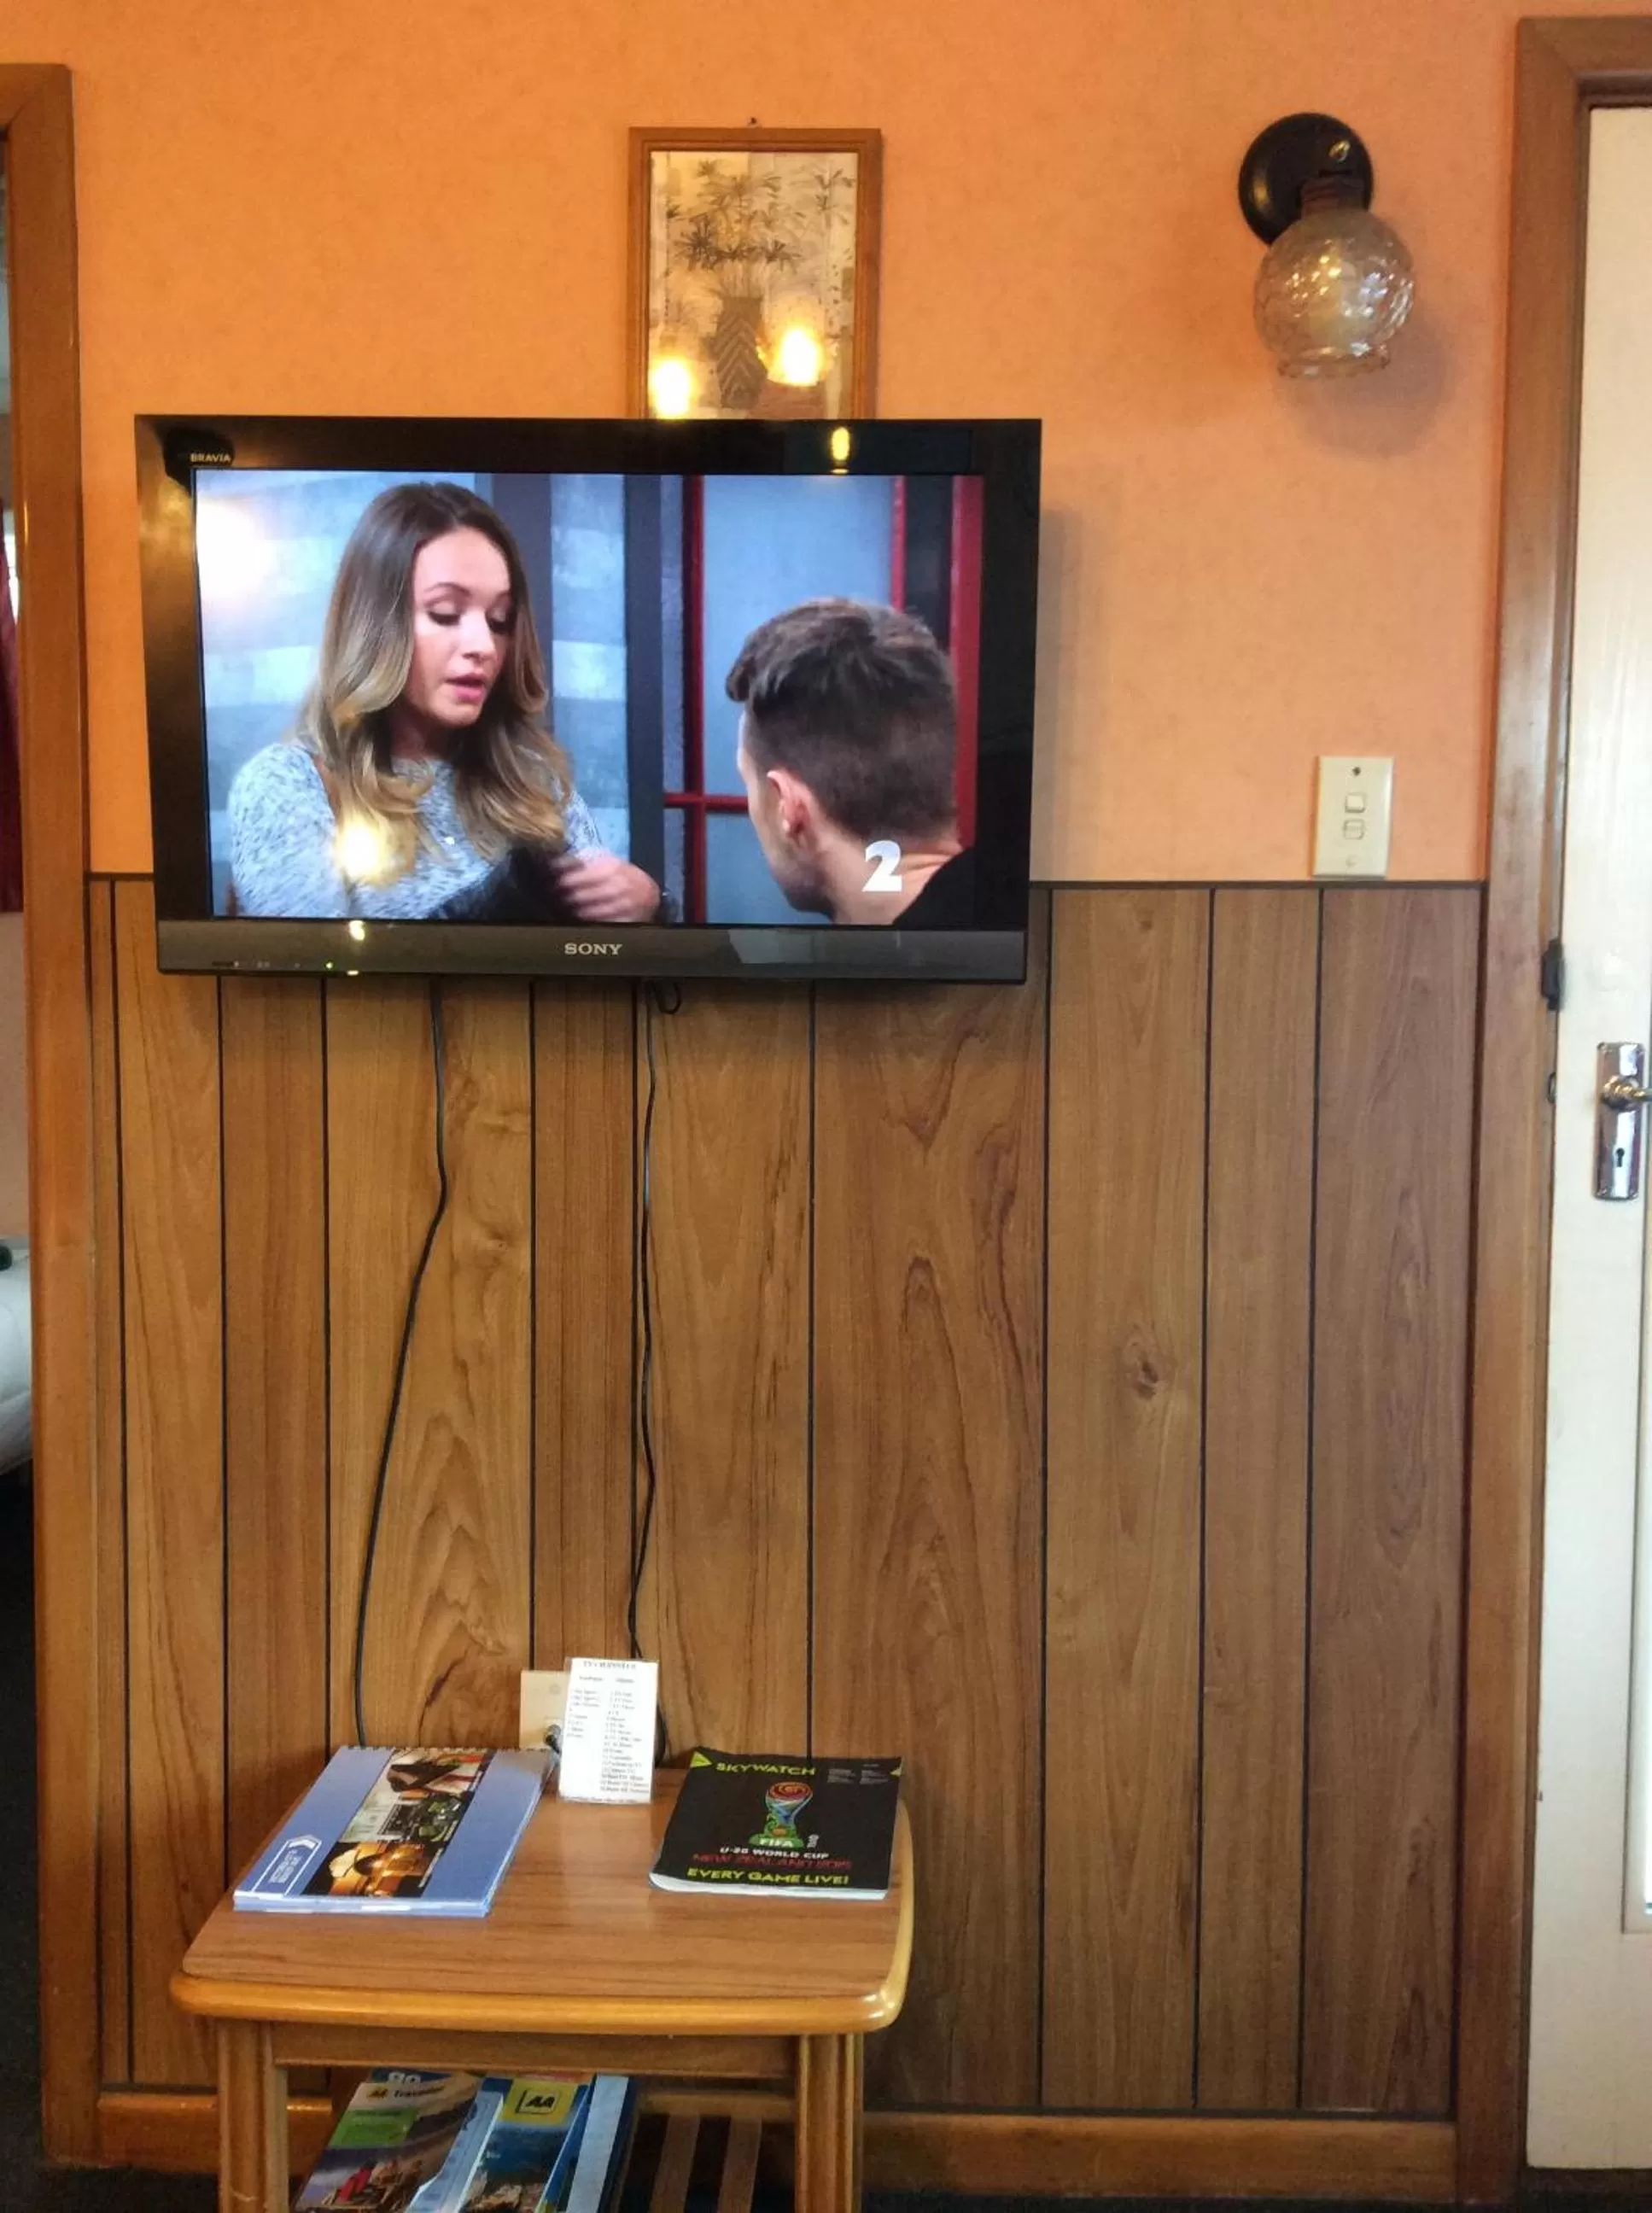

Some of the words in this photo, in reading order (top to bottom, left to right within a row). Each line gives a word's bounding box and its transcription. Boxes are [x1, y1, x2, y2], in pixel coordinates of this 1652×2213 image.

[190, 453, 231, 463] BRAVIA
[861, 839, 902, 892] 2
[563, 942, 624, 955] SONY
[715, 1761, 817, 1777] SKYWATCH
[758, 1838, 794, 1848] FIFA
[752, 1848, 800, 1858] WORLD
[687, 1867, 745, 1879] EVERY
[748, 1871, 801, 1883] GAME
[805, 1874, 849, 1885] LIVE!
[526, 2095, 555, 2109] AA
